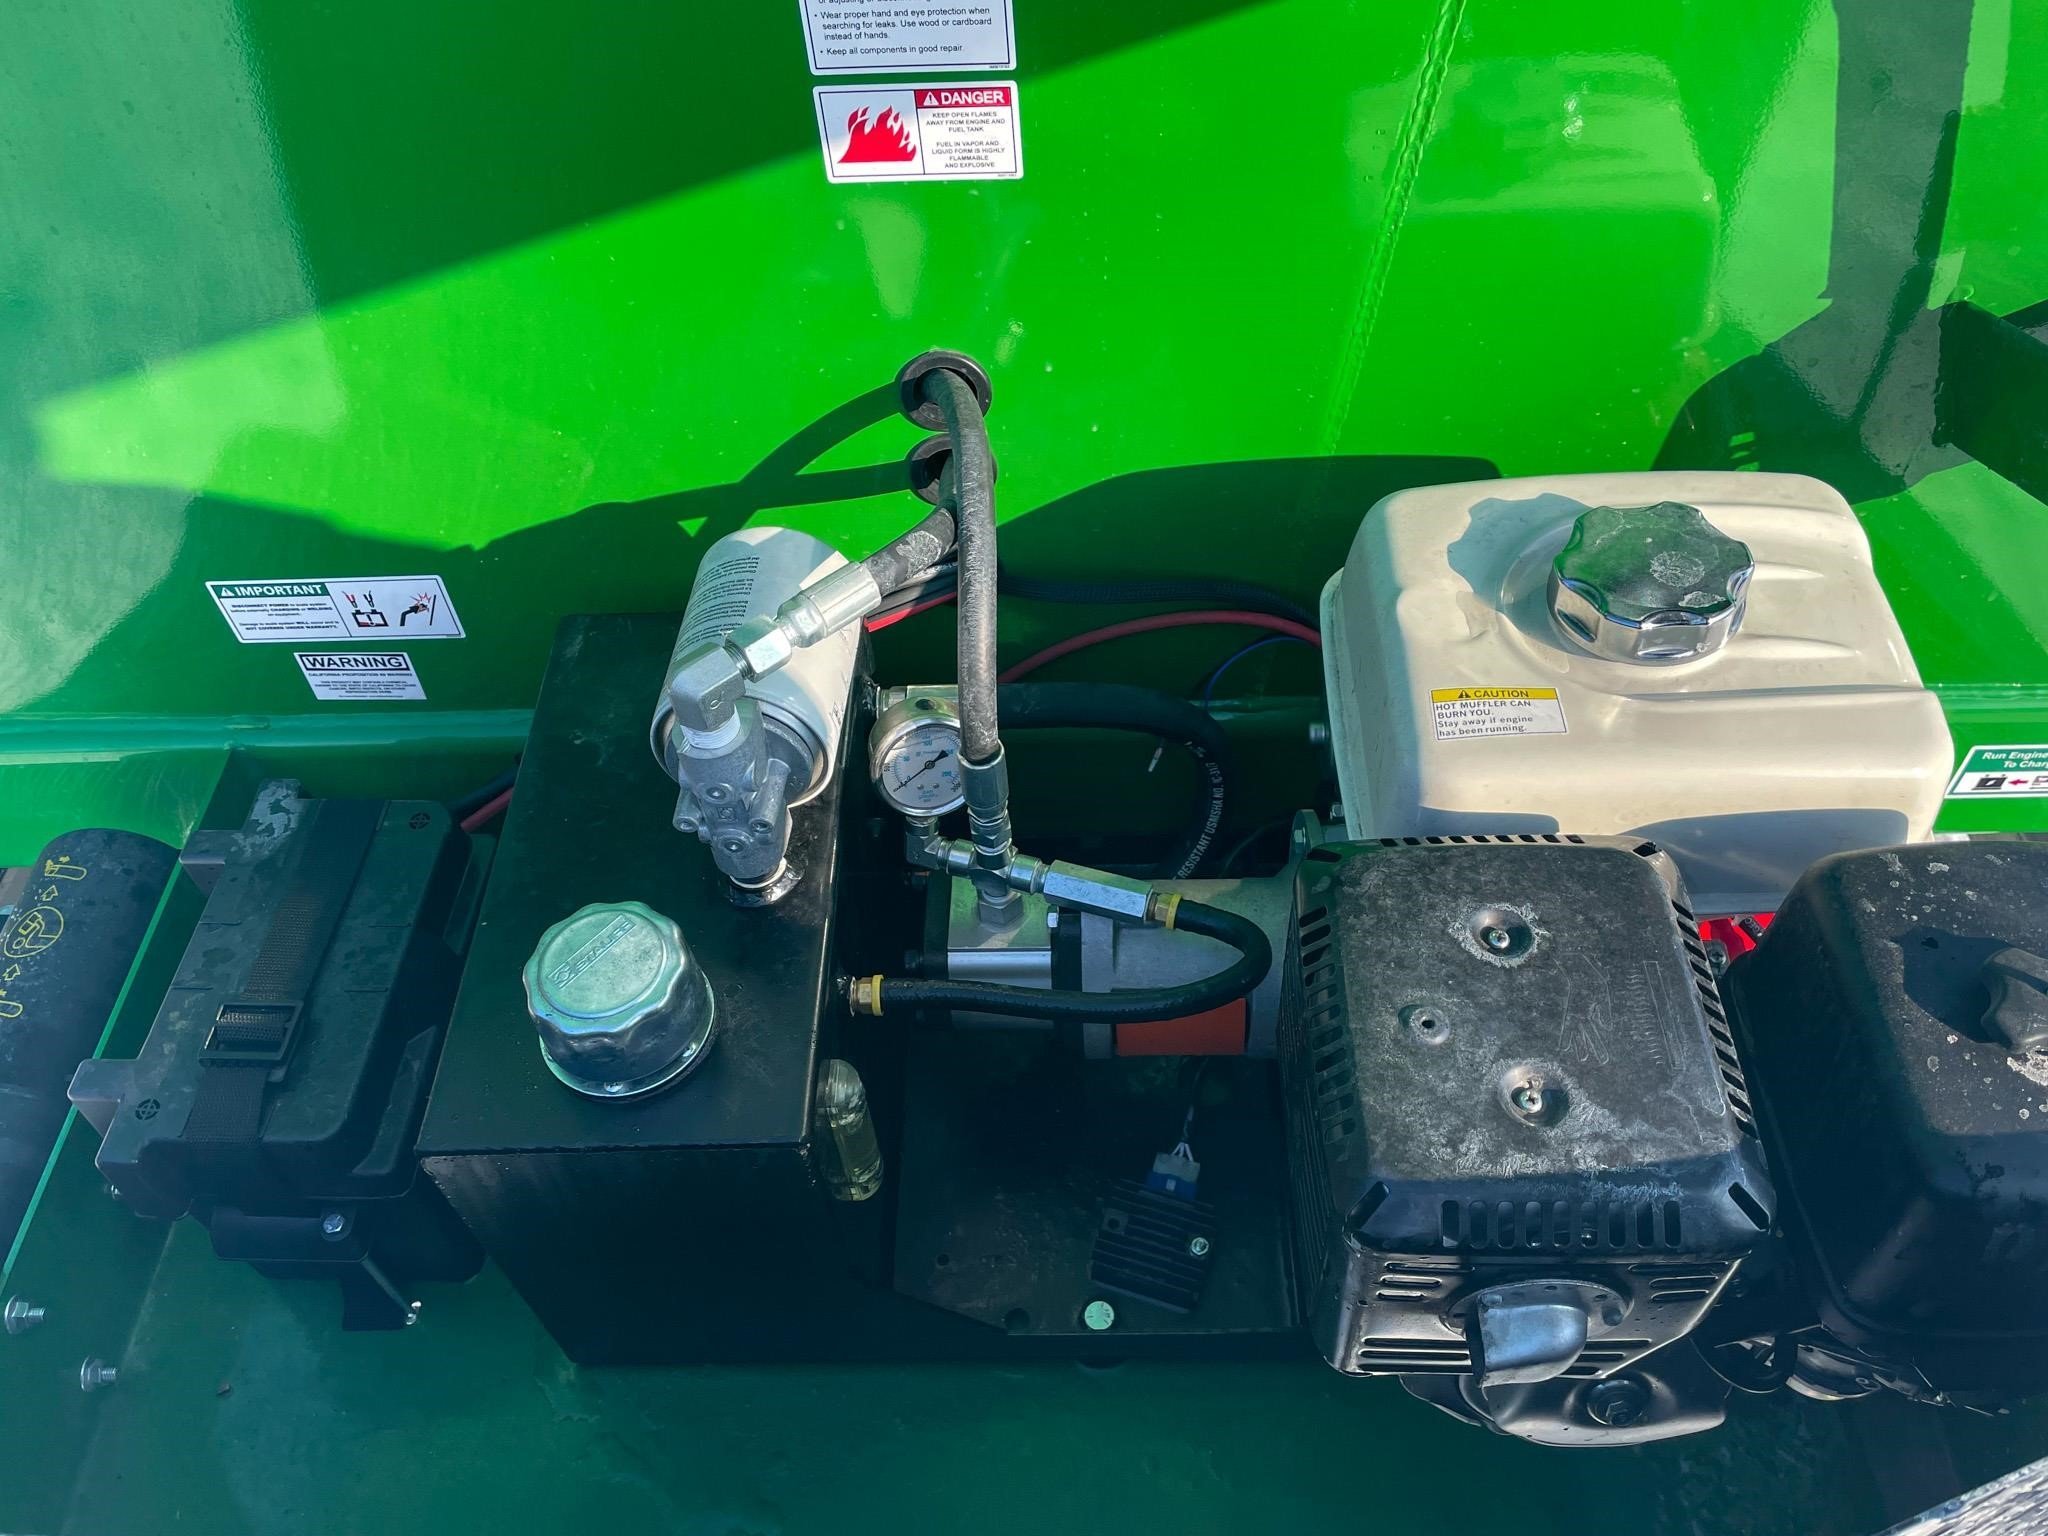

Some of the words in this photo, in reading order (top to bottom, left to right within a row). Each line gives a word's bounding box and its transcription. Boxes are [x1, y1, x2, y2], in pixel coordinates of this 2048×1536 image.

[820, 11, 841, 19] Wear
[844, 11, 869, 20] proper
[872, 9, 891, 17] hand
[894, 9, 908, 17] and
[910, 9, 925, 17] eye
[927, 7, 967, 17] protection
[822, 22, 861, 30] searching
[862, 21, 873, 29] for
[875, 20, 897, 28] leaks.
[951, 17, 992, 26] cardboard
[824, 32, 852, 40] instead
[854, 31, 862, 39] of
[826, 47, 847, 56] Keep
[860, 46, 907, 55] components
[918, 44, 938, 54] good
[941, 90, 1005, 105] DANGER
[234, 584, 322, 597] IMPORTANT
[305, 657, 403, 668] WARNING
[1473, 690, 1529, 699] CAUTION
[1435, 703, 1456, 711] HOT
[1460, 701, 1507, 709] MUFFLER
[1437, 711, 1467, 720] BURN
[1470, 709, 1493, 717] YOU.
[1438, 720, 1459, 728] Stay
[1462, 718, 1486, 727] away
[1499, 716, 1533, 724] engine
[1439, 729, 1456, 737] has
[1459, 726, 1483, 735] been
[1485, 725, 1527, 733] running.
[1982, 751, 2006, 760] Run
[2003, 760, 2017, 768] To
[1177, 833, 1212, 879] RESISTANT
